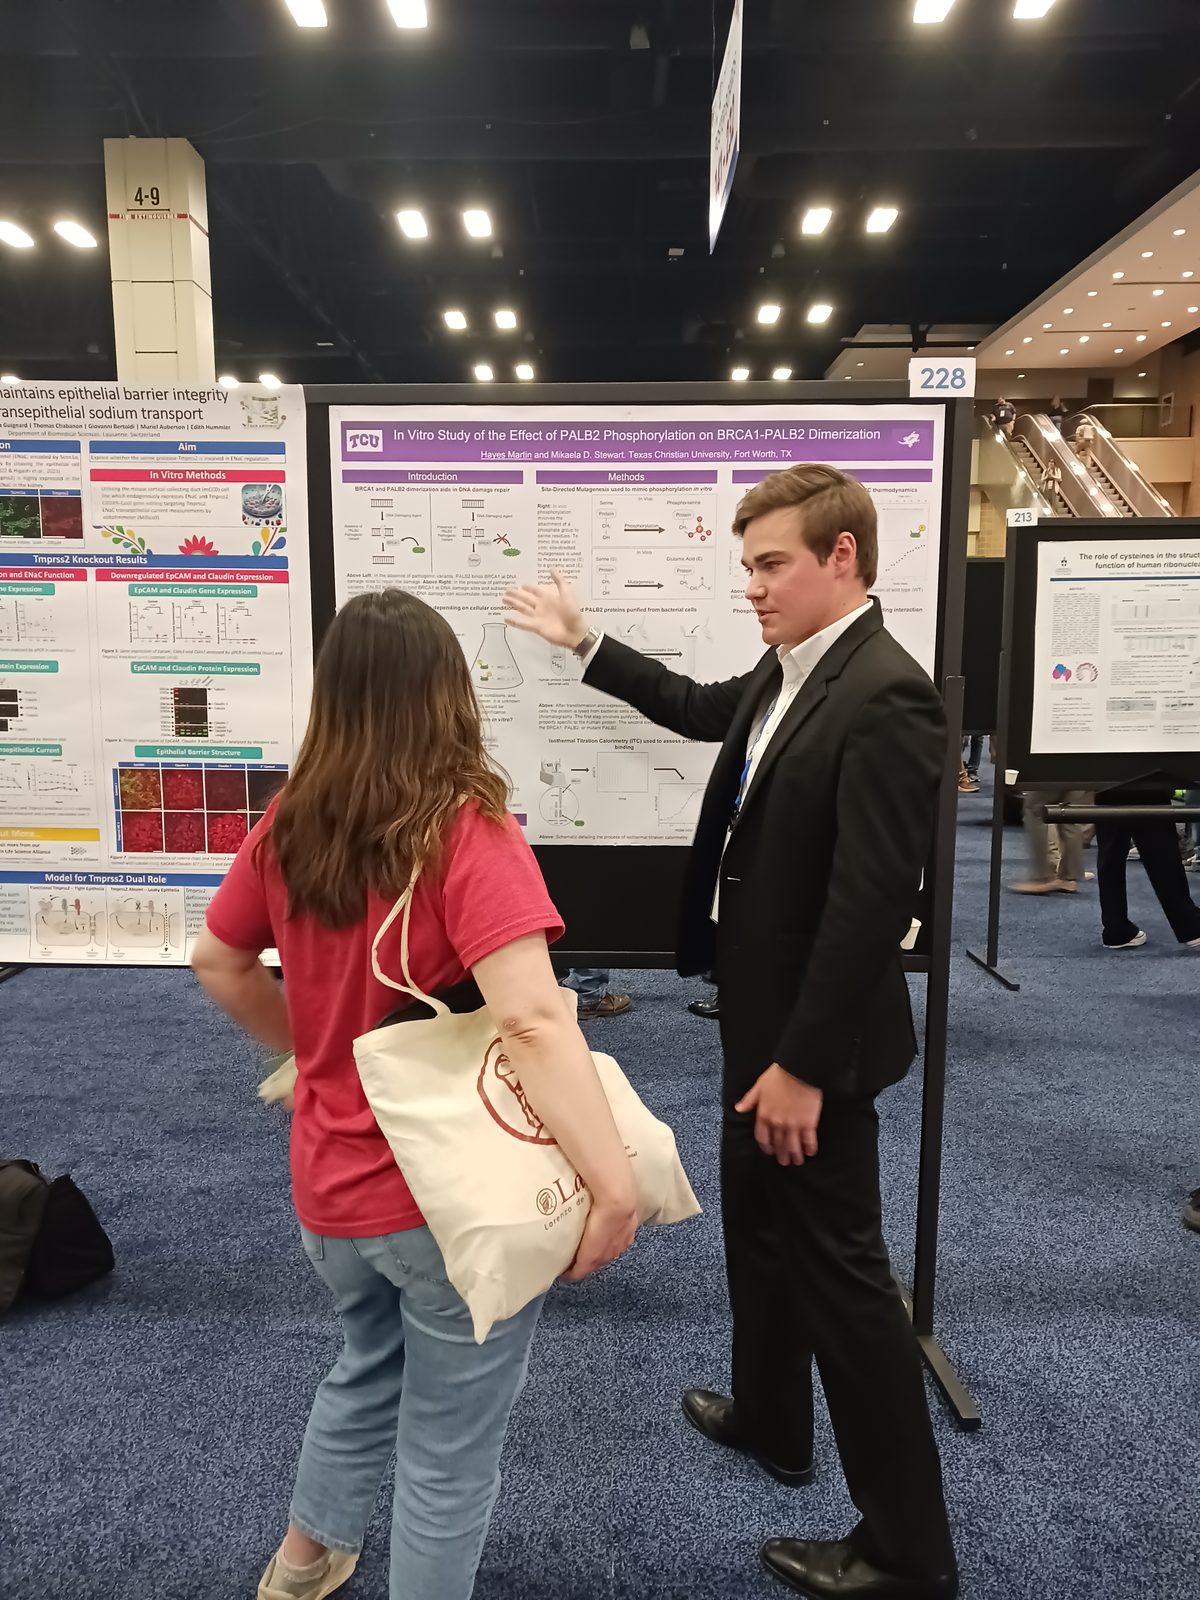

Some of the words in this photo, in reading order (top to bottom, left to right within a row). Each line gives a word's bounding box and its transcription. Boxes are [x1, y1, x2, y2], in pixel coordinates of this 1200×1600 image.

[134, 187, 160, 206] 4-9
[921, 368, 966, 389] 228
[58, 387, 120, 402] epithelial
[123, 387, 168, 401] barrier
[173, 388, 229, 404] integrity
[89, 406, 138, 419] sodium
[141, 408, 204, 422] transport
[349, 433, 380, 448] TCU
[394, 430, 405, 441] In
[407, 430, 434, 441] Vitro
[438, 430, 471, 443] Study
[474, 430, 487, 441] of
[488, 430, 506, 441] the
[509, 430, 542, 441] Effect
[545, 430, 557, 441] of
[560, 430, 600, 441] PALB2
[604, 429, 695, 443] Phosphorylation
[699, 432, 713, 441] on
[717, 429, 805, 440] BRCA1-PALB2
[809, 428, 881, 440] Dimerization
[178, 443, 197, 451] Aim
[481, 450, 505, 460] Hayes
[508, 450, 532, 459] Martin
[534, 451, 549, 459] and
[551, 450, 581, 459] Mikaela
[583, 451, 592, 459] D.
[629, 451, 652, 459] Texas
[654, 450, 689, 459] Christian
[691, 450, 732, 459] University,
[734, 450, 750, 458] Fort
[752, 450, 778, 459] Worth,
[781, 450, 792, 458] TX
[149, 471, 159, 479] In
[160, 470, 183, 479] Vitro
[186, 470, 227, 480] Methods
[408, 472, 458, 481] Introduction
[608, 472, 645, 481] Methods
[1014, 513, 1032, 522] 213
[33, 555, 70, 565] Tmprss2
[72, 555, 114, 564] Knockout
[116, 555, 148, 564] Results
[1119, 553, 1154, 561] cysteines
[111, 572, 164, 581] Downregulated
[165, 573, 191, 581] EpCAM
[236, 574, 273, 582] Expression
[134, 587, 158, 595] EpCAM
[16, 663, 49, 671] Expression
[133, 664, 157, 672] EpCAM
[156, 748, 186, 756] Epithelial
[45, 873, 72, 882] Model
[74, 874, 87, 882] for
[88, 875, 124, 884] Tmprss2
[126, 875, 146, 883] Dual
[148, 875, 167, 884] Role
[544, 1206, 572, 1231] Lorenzo
